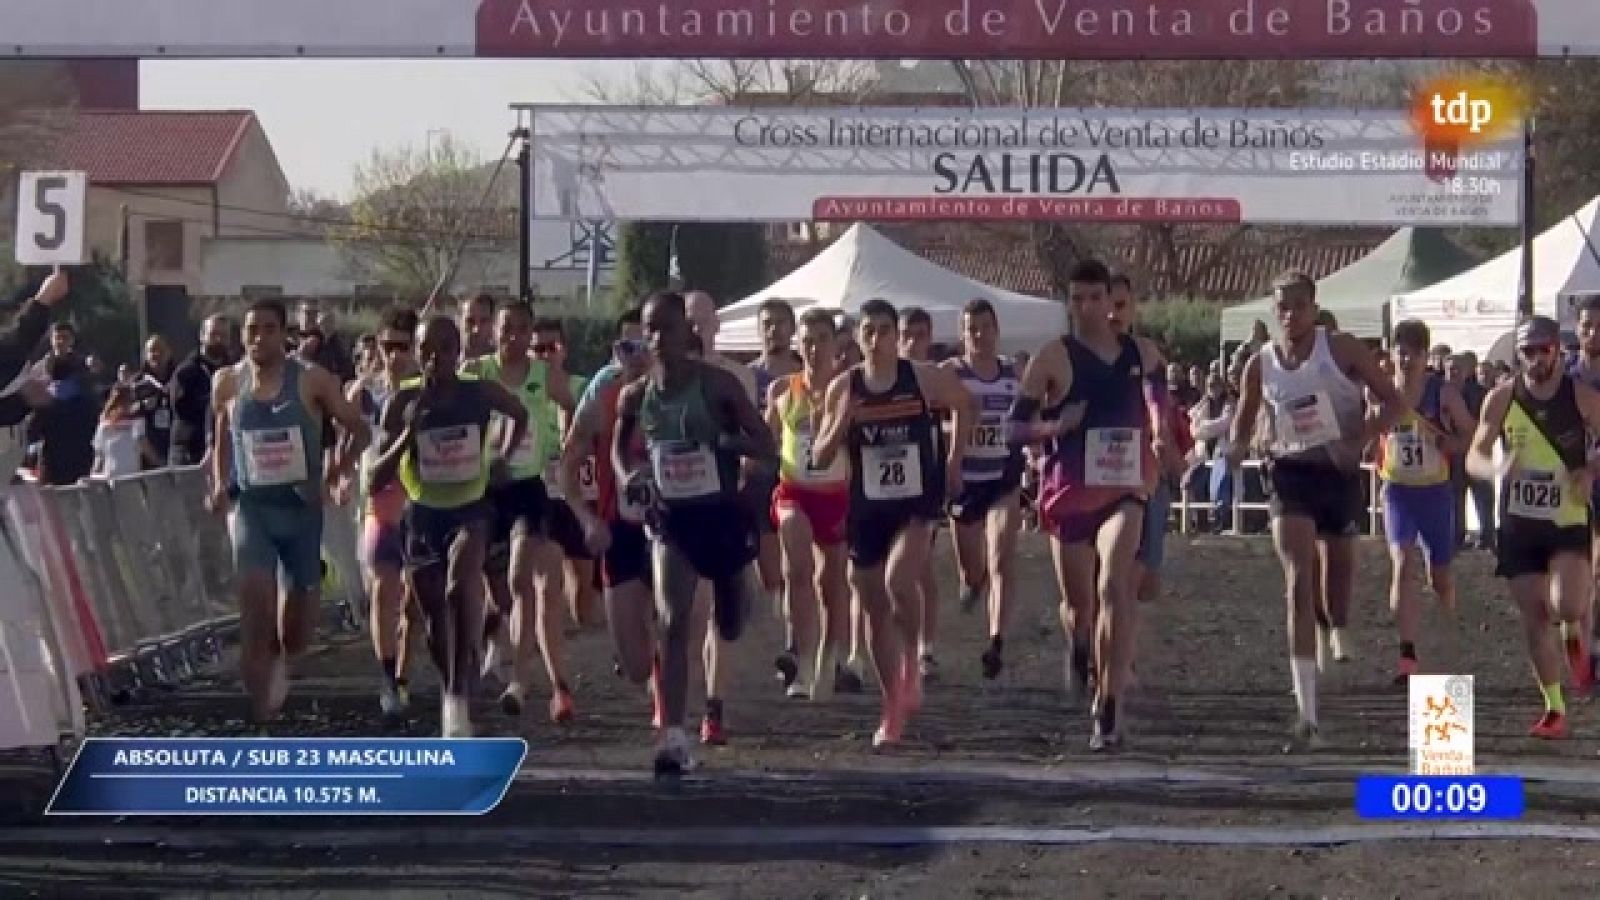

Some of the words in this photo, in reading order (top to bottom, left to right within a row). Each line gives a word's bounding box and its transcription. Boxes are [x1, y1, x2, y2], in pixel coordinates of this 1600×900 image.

[509, 0, 911, 48] Ayuntamiento
[944, 0, 1006, 36] de
[1035, 0, 1193, 36] Venta
[1229, 0, 1290, 36] de
[1326, 0, 1494, 36] Baños
[733, 116, 818, 147] Cross
[828, 116, 1028, 147] Internacional
[1039, 116, 1078, 148] de
[1081, 117, 1171, 148] Venta
[1179, 116, 1220, 148] de
[1229, 118, 1324, 148] Baños
[933, 151, 1121, 193] SALIDA
[34, 177, 67, 250] 5
[825, 199, 991, 218] Ayuntamiento
[1002, 199, 1028, 216] de
[1039, 199, 1104, 217] Venta
[1116, 199, 1145, 217] de
[1401, 447, 1424, 466] 31
[878, 463, 906, 486] 28
[1511, 480, 1562, 508] 1028
